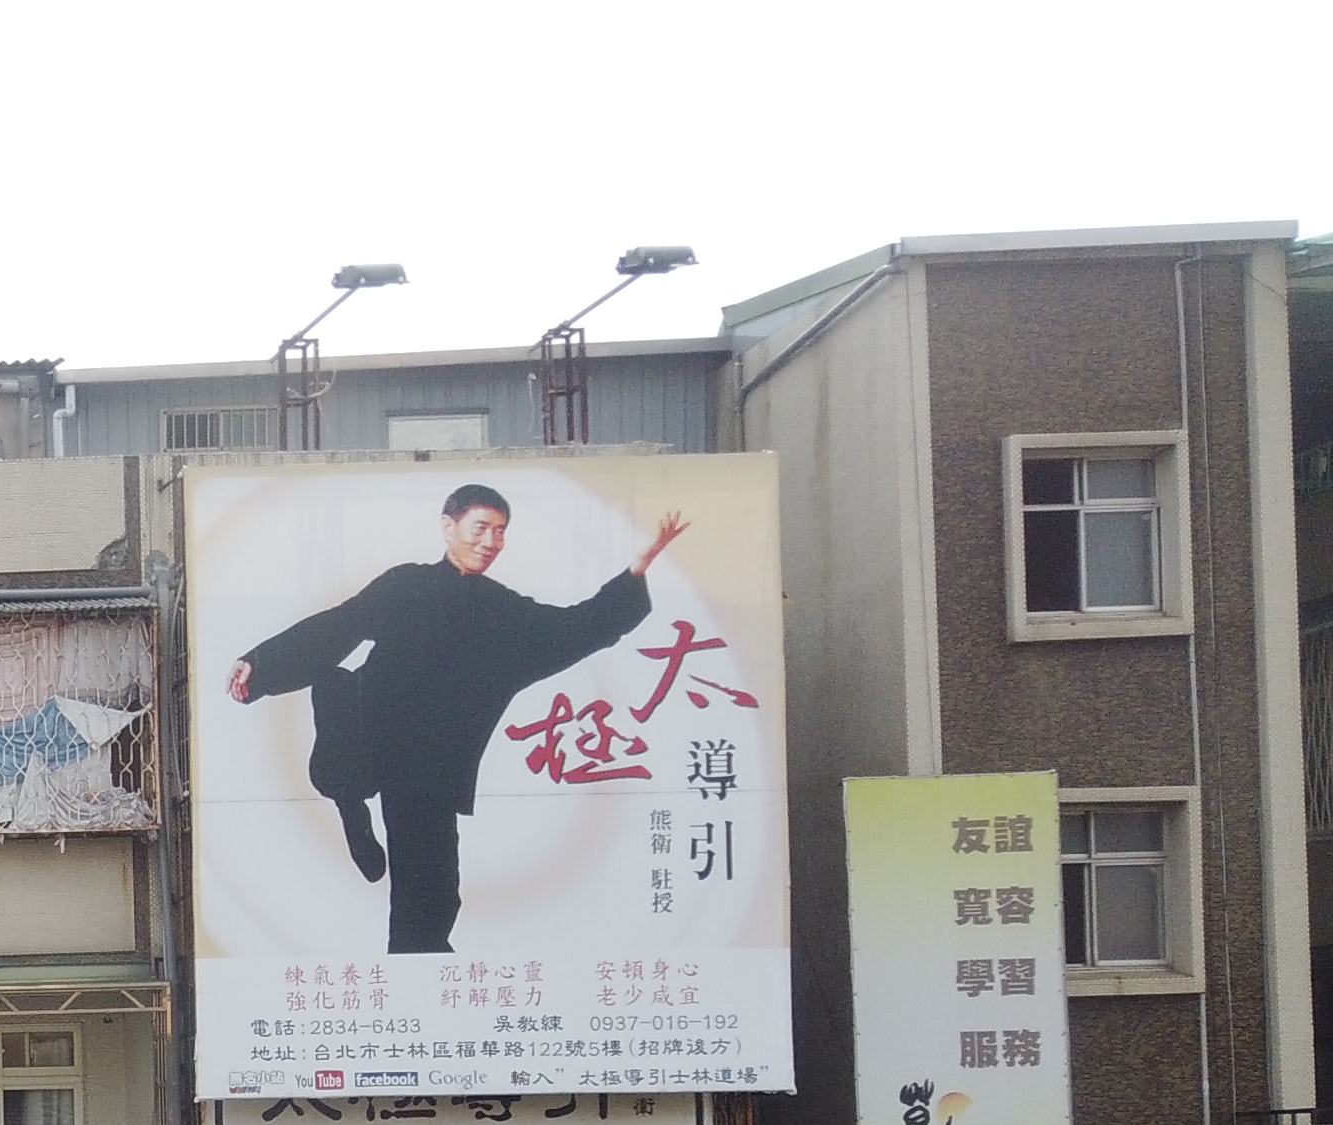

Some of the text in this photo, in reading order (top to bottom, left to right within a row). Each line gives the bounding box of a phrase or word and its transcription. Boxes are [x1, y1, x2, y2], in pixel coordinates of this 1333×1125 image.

[506, 619, 760, 785] 太極
[686, 738, 738, 882] 導引
[952, 815, 1034, 854] 友誼
[953, 887, 1036, 926] 寬容
[284, 960, 700, 987] 練氣養生 沉靜心靈 安頓身心
[956, 958, 1037, 998] 學習
[286, 989, 390, 1011] 強化筋骨
[595, 984, 701, 1007] 老少咸宜
[590, 1013, 739, 1032] 0937-016-192
[959, 1029, 1042, 1069] 服務
[355, 1072, 417, 1086] facebook
[428, 1070, 487, 1090] Google
